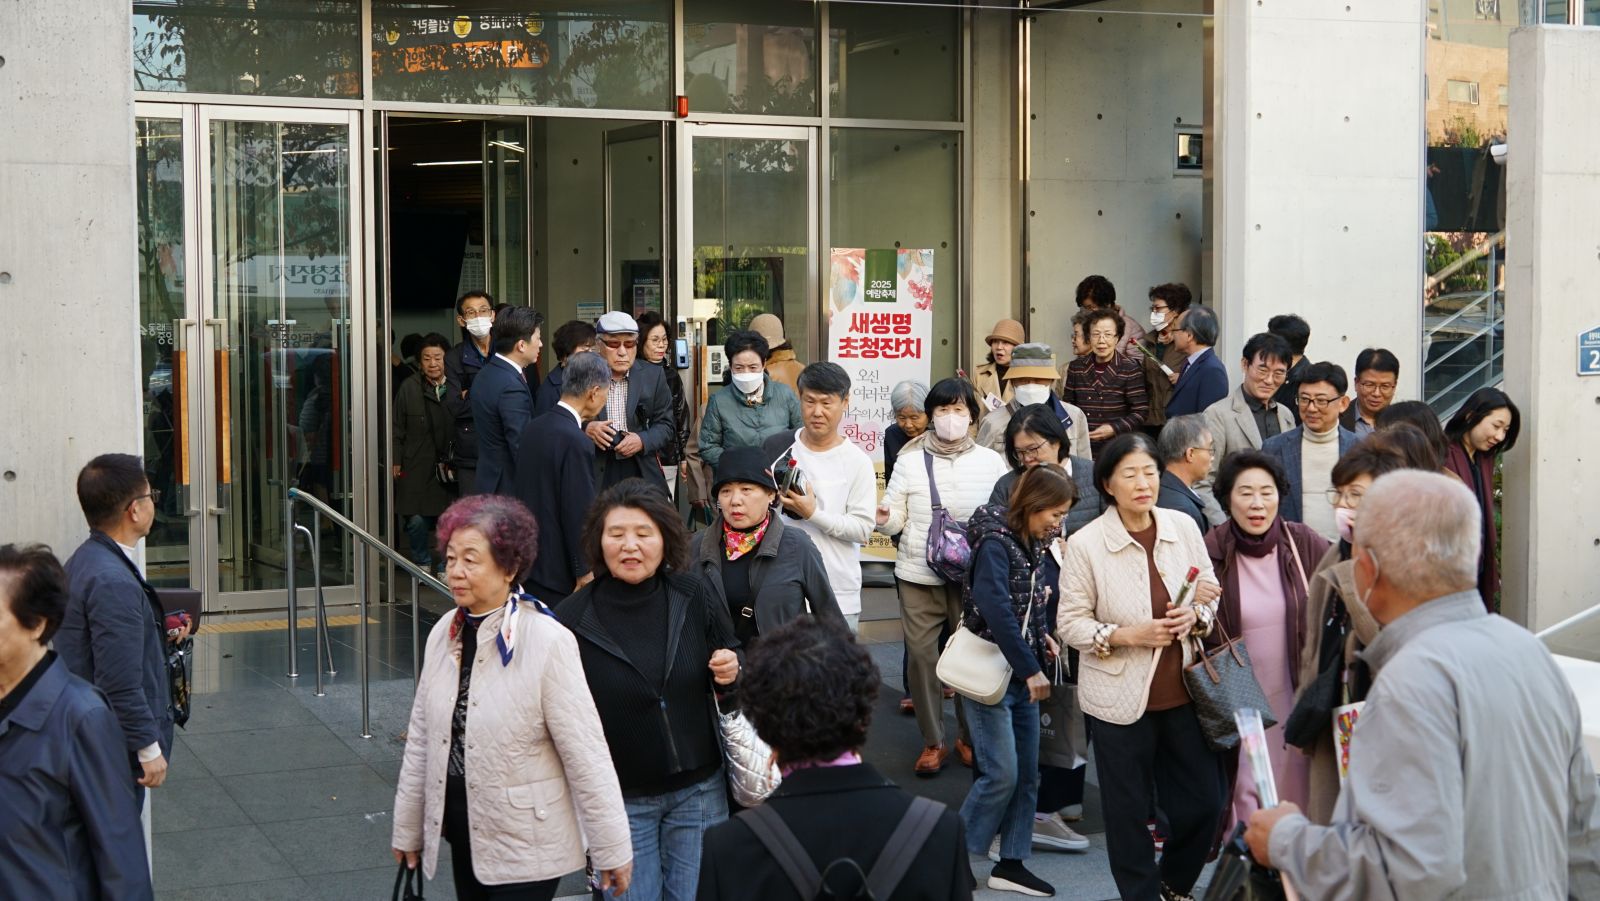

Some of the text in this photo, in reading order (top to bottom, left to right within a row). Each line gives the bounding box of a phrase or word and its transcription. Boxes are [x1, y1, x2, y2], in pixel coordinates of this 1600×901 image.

[871, 280, 892, 289] 2025
[866, 289, 896, 299] 예람축제
[148, 323, 166, 336] 동래
[848, 312, 912, 335] 새생명
[838, 337, 922, 359] 초청잔치
[1589, 350, 1600, 369] 2
[856, 369, 880, 384] 오신
[853, 386, 893, 403] 여러분
[868, 537, 893, 547] 동래중앙
[1040, 728, 1056, 737] OTTE
